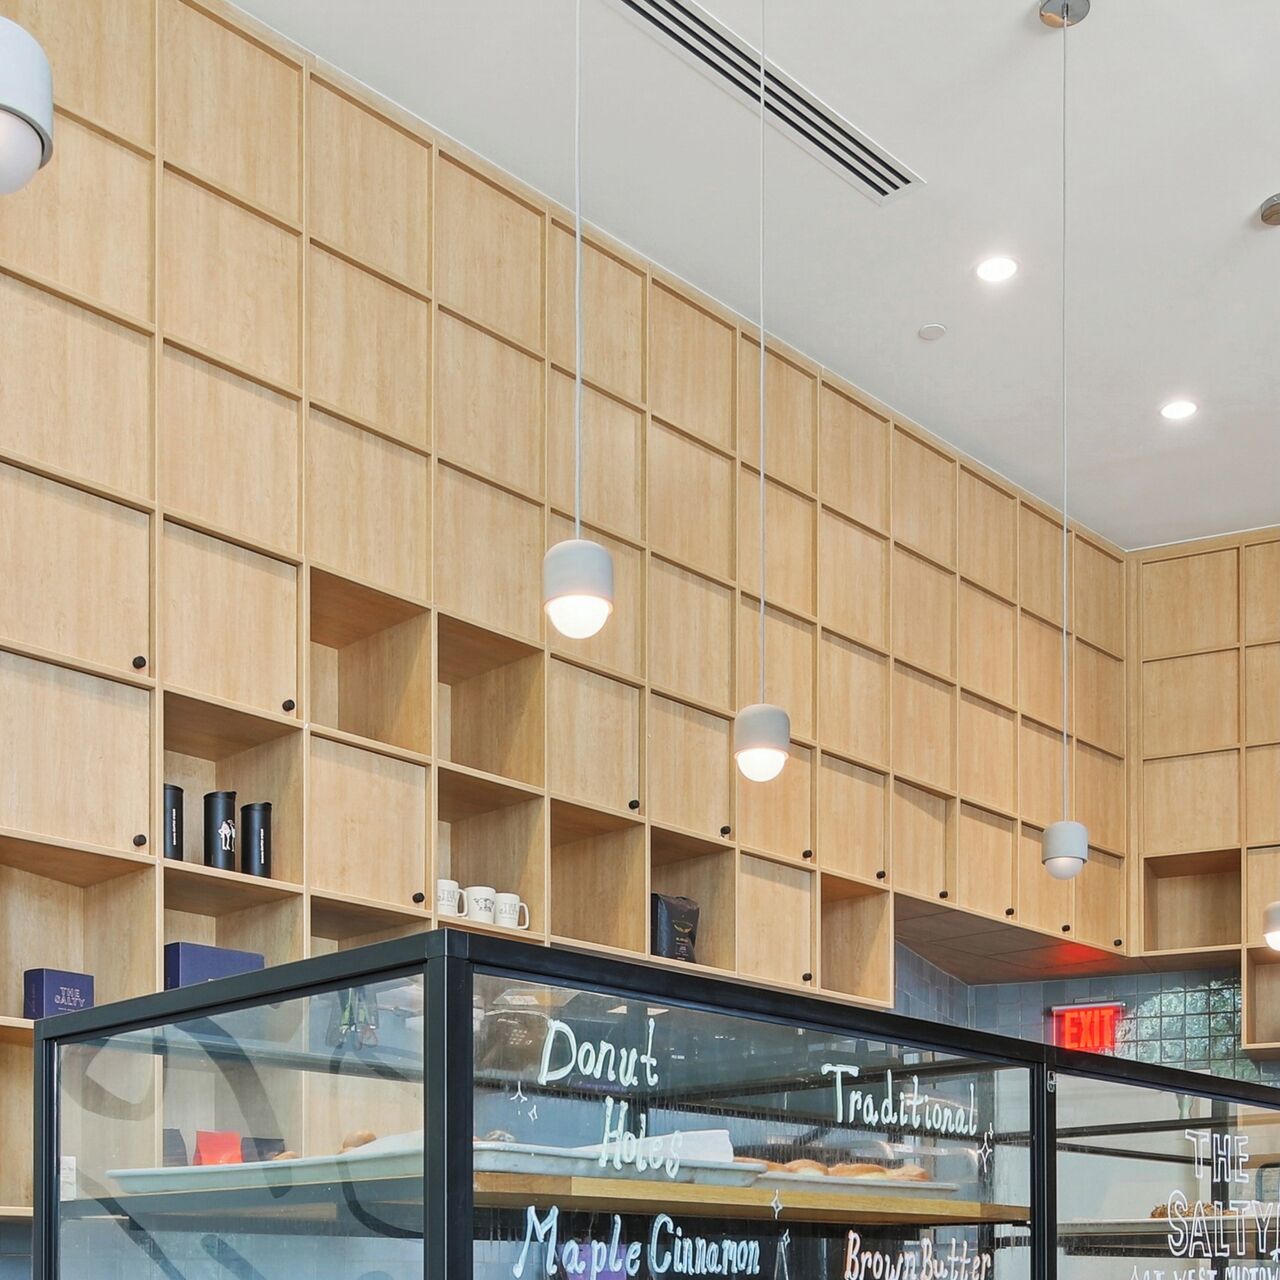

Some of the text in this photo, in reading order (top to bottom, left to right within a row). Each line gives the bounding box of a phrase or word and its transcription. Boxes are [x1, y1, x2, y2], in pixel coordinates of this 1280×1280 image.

[59, 986, 80, 998] THE
[537, 1018, 659, 1087] Donut
[1065, 1009, 1114, 1049] EXIT
[822, 1063, 977, 1136] Traditional
[599, 1096, 683, 1178] Holes
[1184, 1129, 1250, 1184] THE
[647, 1213, 761, 1277] Cinnamon
[1167, 1190, 1278, 1257] SALTY
